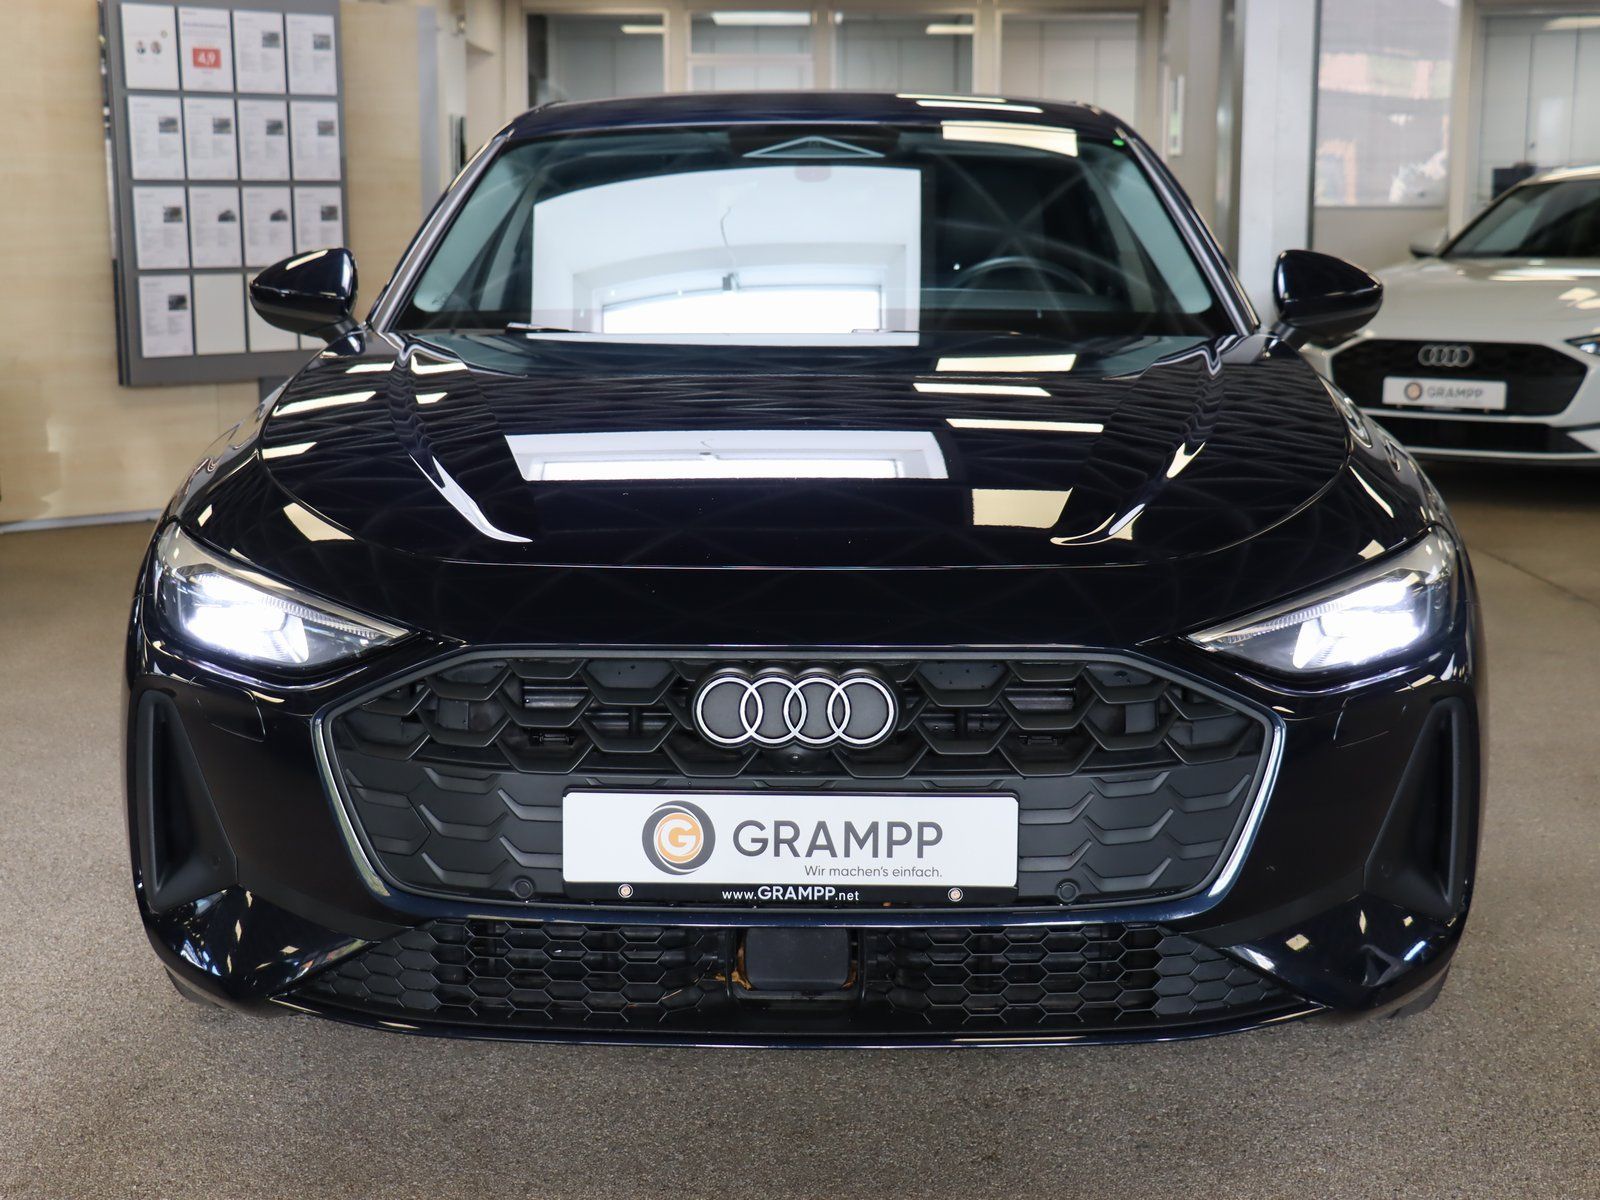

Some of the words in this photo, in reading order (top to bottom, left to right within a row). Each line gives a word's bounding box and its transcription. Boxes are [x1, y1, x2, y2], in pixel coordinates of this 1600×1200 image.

[1427, 386, 1484, 399] GRAMPP
[661, 819, 696, 856] G
[732, 819, 943, 859] GRAMPP
[804, 865, 826, 876] Wir
[892, 866, 943, 878] einfach.
[721, 885, 859, 901] www.GRAMPP.net
